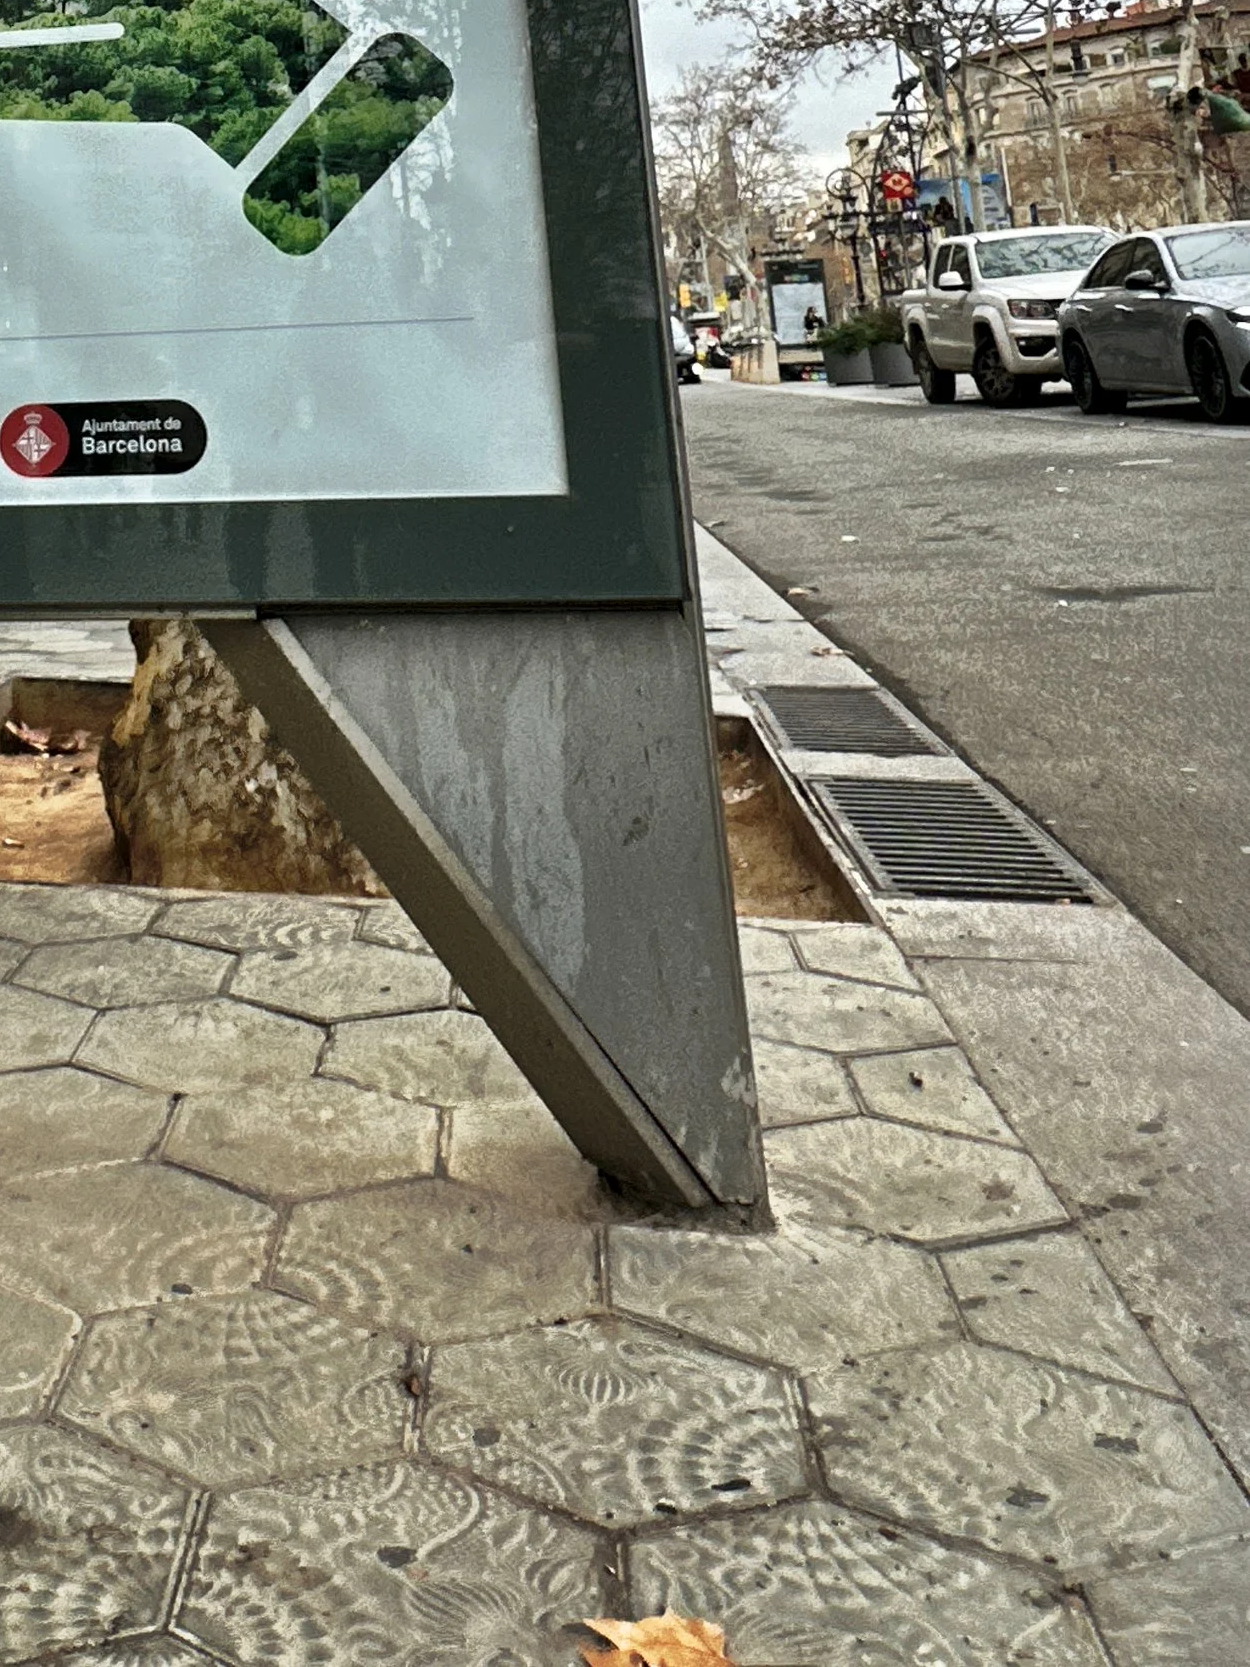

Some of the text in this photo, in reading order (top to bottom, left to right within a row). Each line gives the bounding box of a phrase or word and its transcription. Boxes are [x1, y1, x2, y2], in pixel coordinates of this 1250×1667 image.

[82, 416, 182, 435] Ajuntament de
[82, 435, 183, 455] Barcelona
